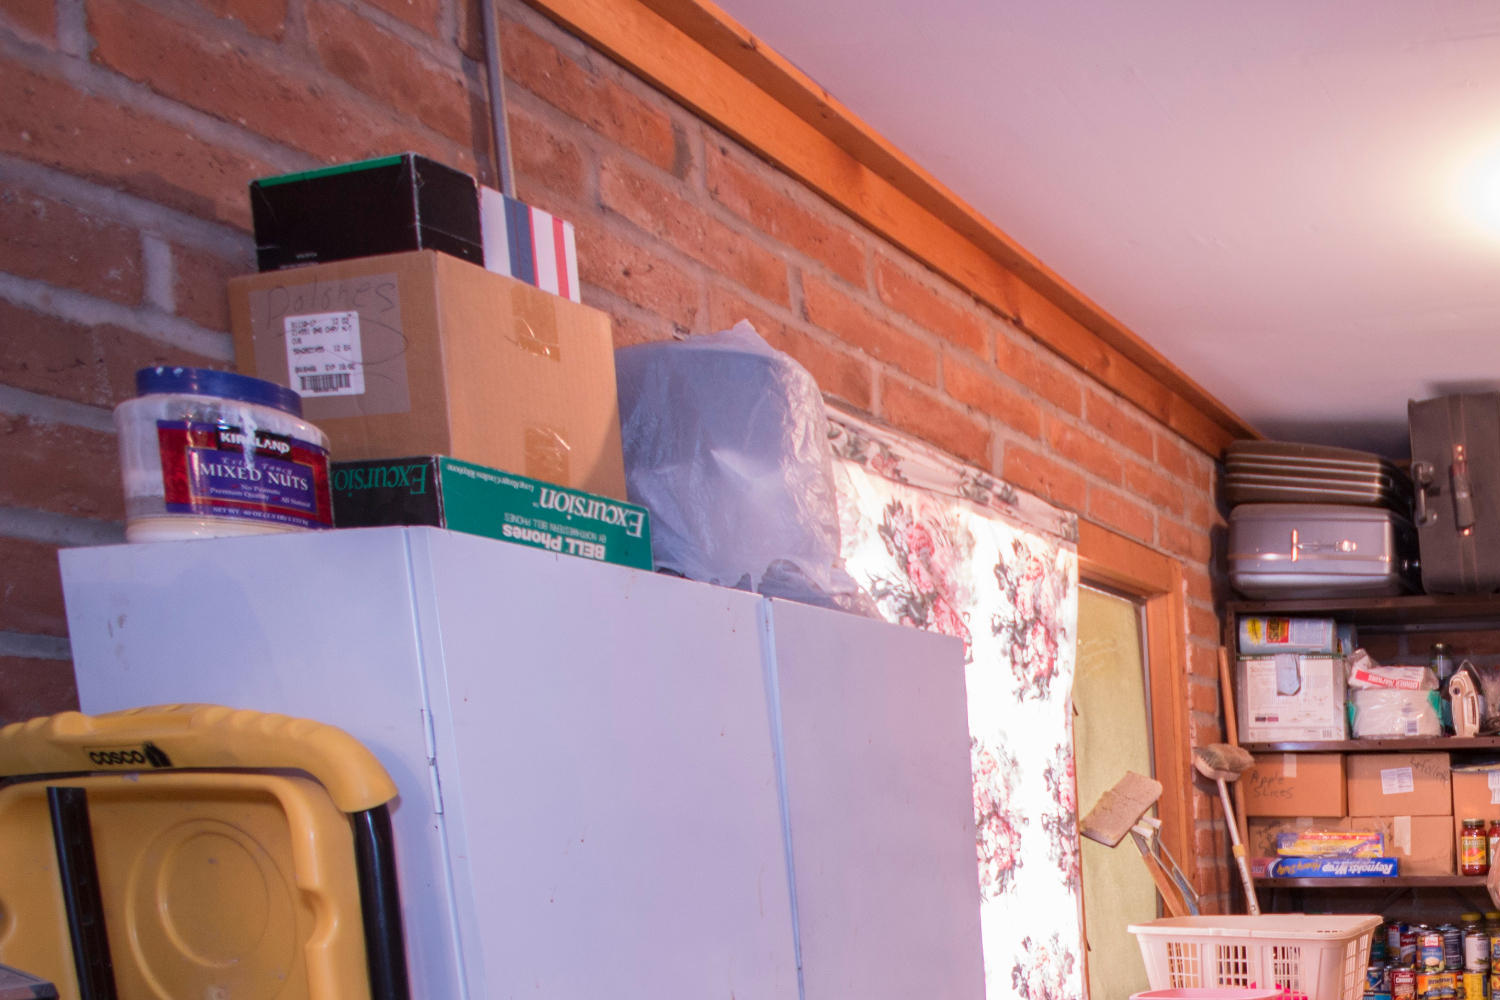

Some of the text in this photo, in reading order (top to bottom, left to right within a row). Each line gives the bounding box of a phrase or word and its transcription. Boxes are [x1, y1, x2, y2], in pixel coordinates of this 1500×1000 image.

[220, 432, 291, 454] KIRLAND
[201, 463, 309, 491] MIXED NUTS
[331, 464, 428, 496] Excursio
[539, 487, 646, 538] Excursion
[502, 524, 606, 560] BELL Phones
[1322, 861, 1347, 876] Wrap
[1348, 861, 1393, 875] Reynolds
